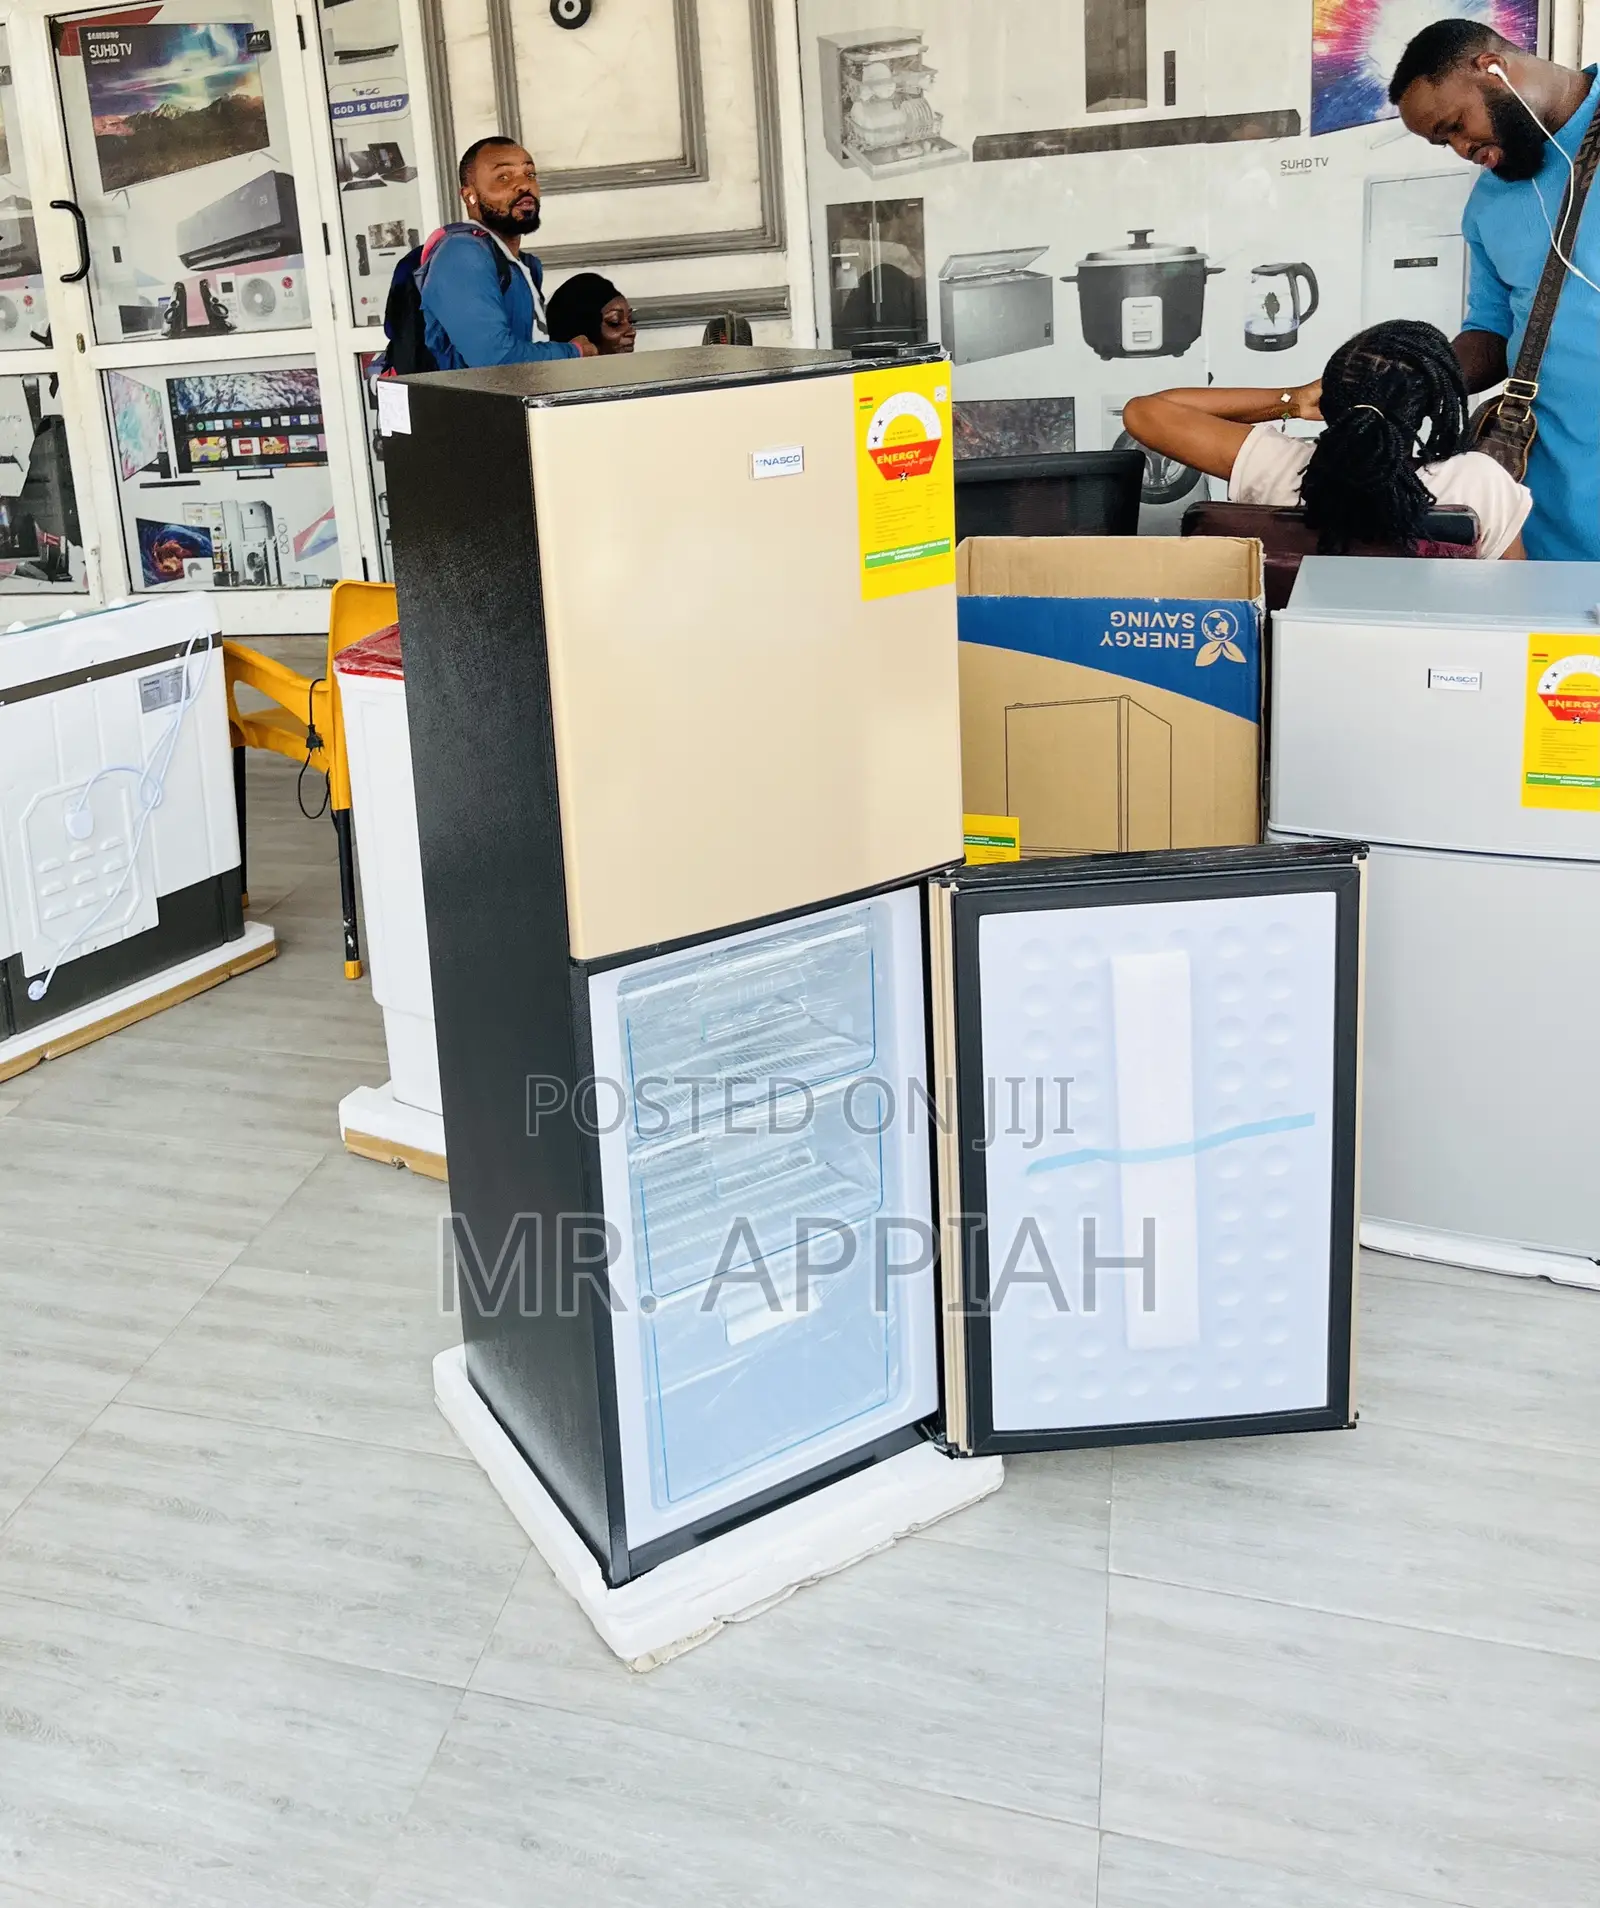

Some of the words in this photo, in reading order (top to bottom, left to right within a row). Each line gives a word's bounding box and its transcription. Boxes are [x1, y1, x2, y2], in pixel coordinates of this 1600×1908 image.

[89, 43, 119, 58] SUHD
[118, 42, 132, 56] TV
[333, 105, 354, 115] GOD
[357, 103, 367, 112] IS
[369, 98, 403, 110] GREAT
[1280, 158, 1312, 170] SUHD
[1313, 156, 1329, 168] TV
[762, 454, 801, 466] NASCO
[876, 449, 921, 464] ENERGY
[1110, 611, 1195, 628] SAVING
[1100, 631, 1195, 649] ENERGY
[1440, 675, 1478, 683] NASCO
[1547, 699, 1599, 709] ENERGY
